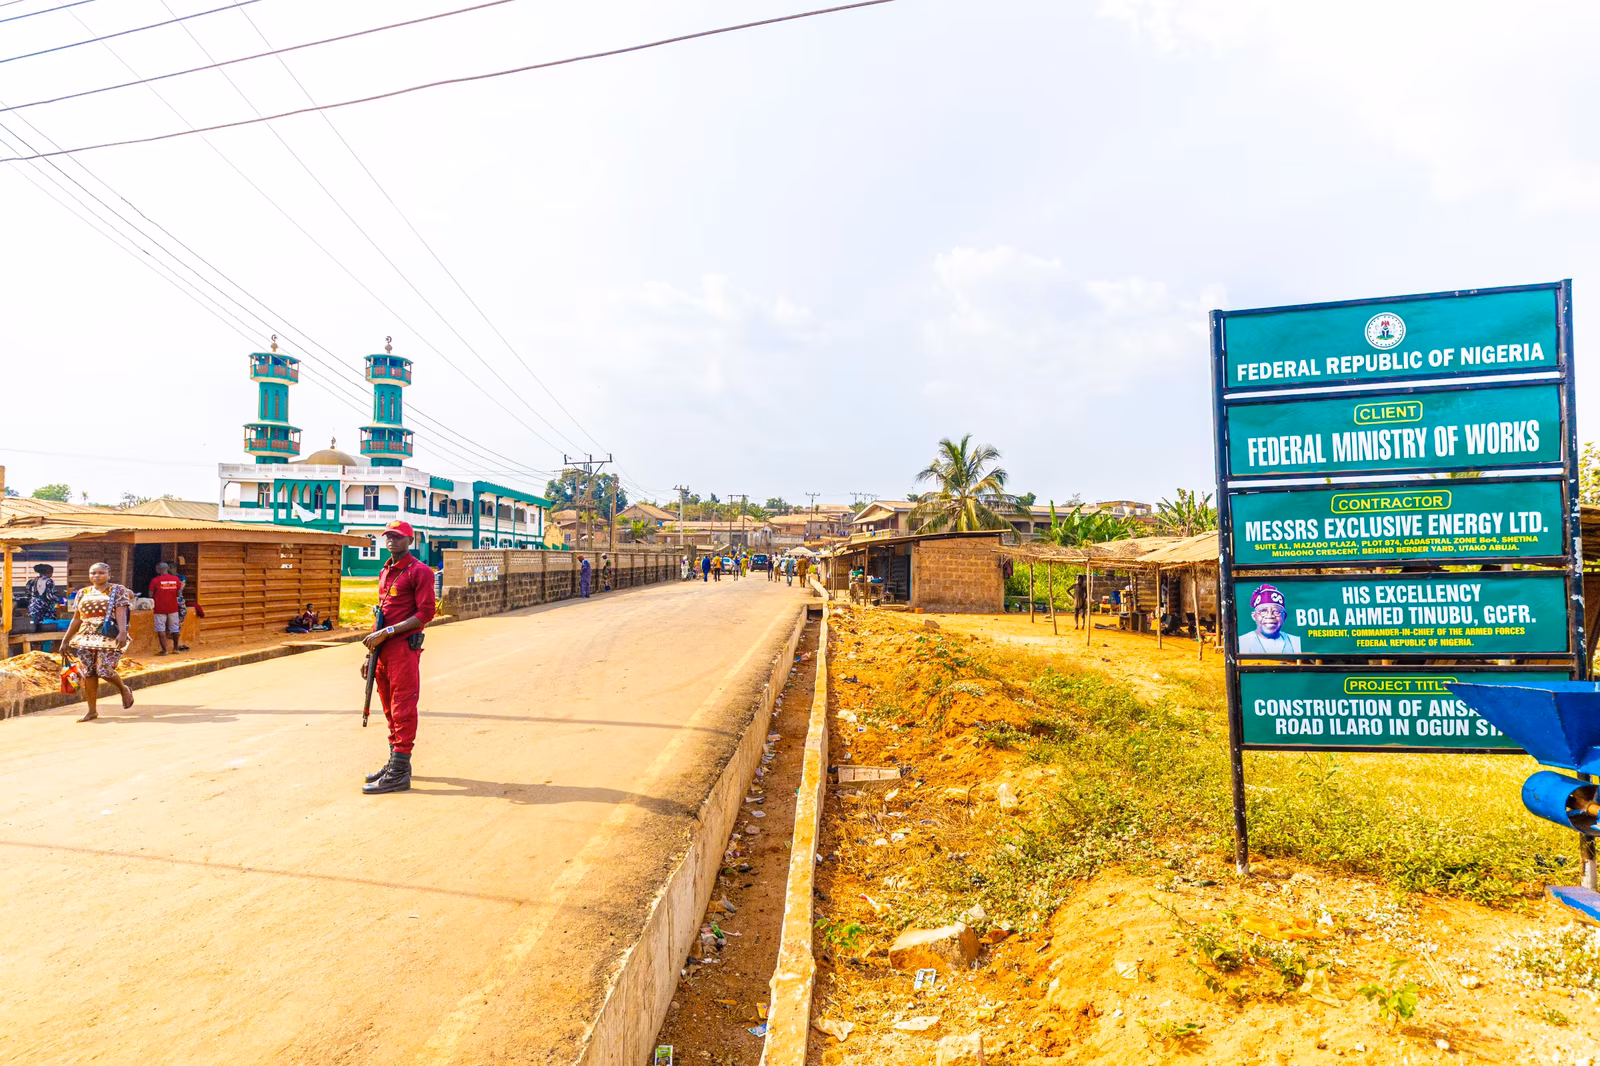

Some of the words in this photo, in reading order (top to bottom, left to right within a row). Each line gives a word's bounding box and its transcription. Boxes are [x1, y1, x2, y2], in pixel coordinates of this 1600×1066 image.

[1238, 359, 1320, 380] FEDERAL
[1326, 351, 1422, 374] REPUBLIC
[1428, 348, 1454, 366] OF
[1461, 343, 1544, 364] NIGERIA
[1360, 406, 1416, 420] CLIENT
[1248, 434, 1326, 466] FEDERAL
[1332, 428, 1426, 462] MINISTRY
[1434, 426, 1458, 456] OF
[1465, 420, 1539, 454] WORKS
[1338, 496, 1443, 510] CONTRACTOR
[1246, 519, 1318, 541] MESSRS
[1325, 516, 1421, 539] EXCLUSIVE
[1429, 512, 1502, 535] ENERGY
[1510, 512, 1548, 532] LTD.
[1254, 543, 1276, 551] SUITE
[1330, 541, 1359, 549] PLAZA,
[1384, 539, 1401, 547] 874,
[1403, 538, 1451, 546] CADASTRAL
[1271, 549, 1315, 557] MUNGONO
[1315, 548, 1359, 556] CRESCENT,
[1361, 547, 1393, 555] BEHIND
[1395, 546, 1429, 554] BERGER
[1342, 586, 1370, 604] HIS
[1376, 584, 1480, 603] EXCELLENCY
[1296, 608, 1339, 626] BOLA
[1345, 608, 1403, 625] AHMED
[1408, 606, 1478, 625] TINUBU,
[1484, 605, 1536, 624] GCFR.
[1352, 628, 1434, 636] COMMANDER-IN-CHIEF
[1440, 638, 1474, 646] NIGERIA.
[1350, 681, 1410, 690] PROJECT
[1254, 700, 1392, 716] CONSTRUCTION
[1399, 700, 1421, 716] OF
[1276, 718, 1323, 734] ROAD
[1330, 718, 1382, 735] ILARO
[1390, 719, 1409, 735] IN
[1416, 720, 1468, 736] OGUN
